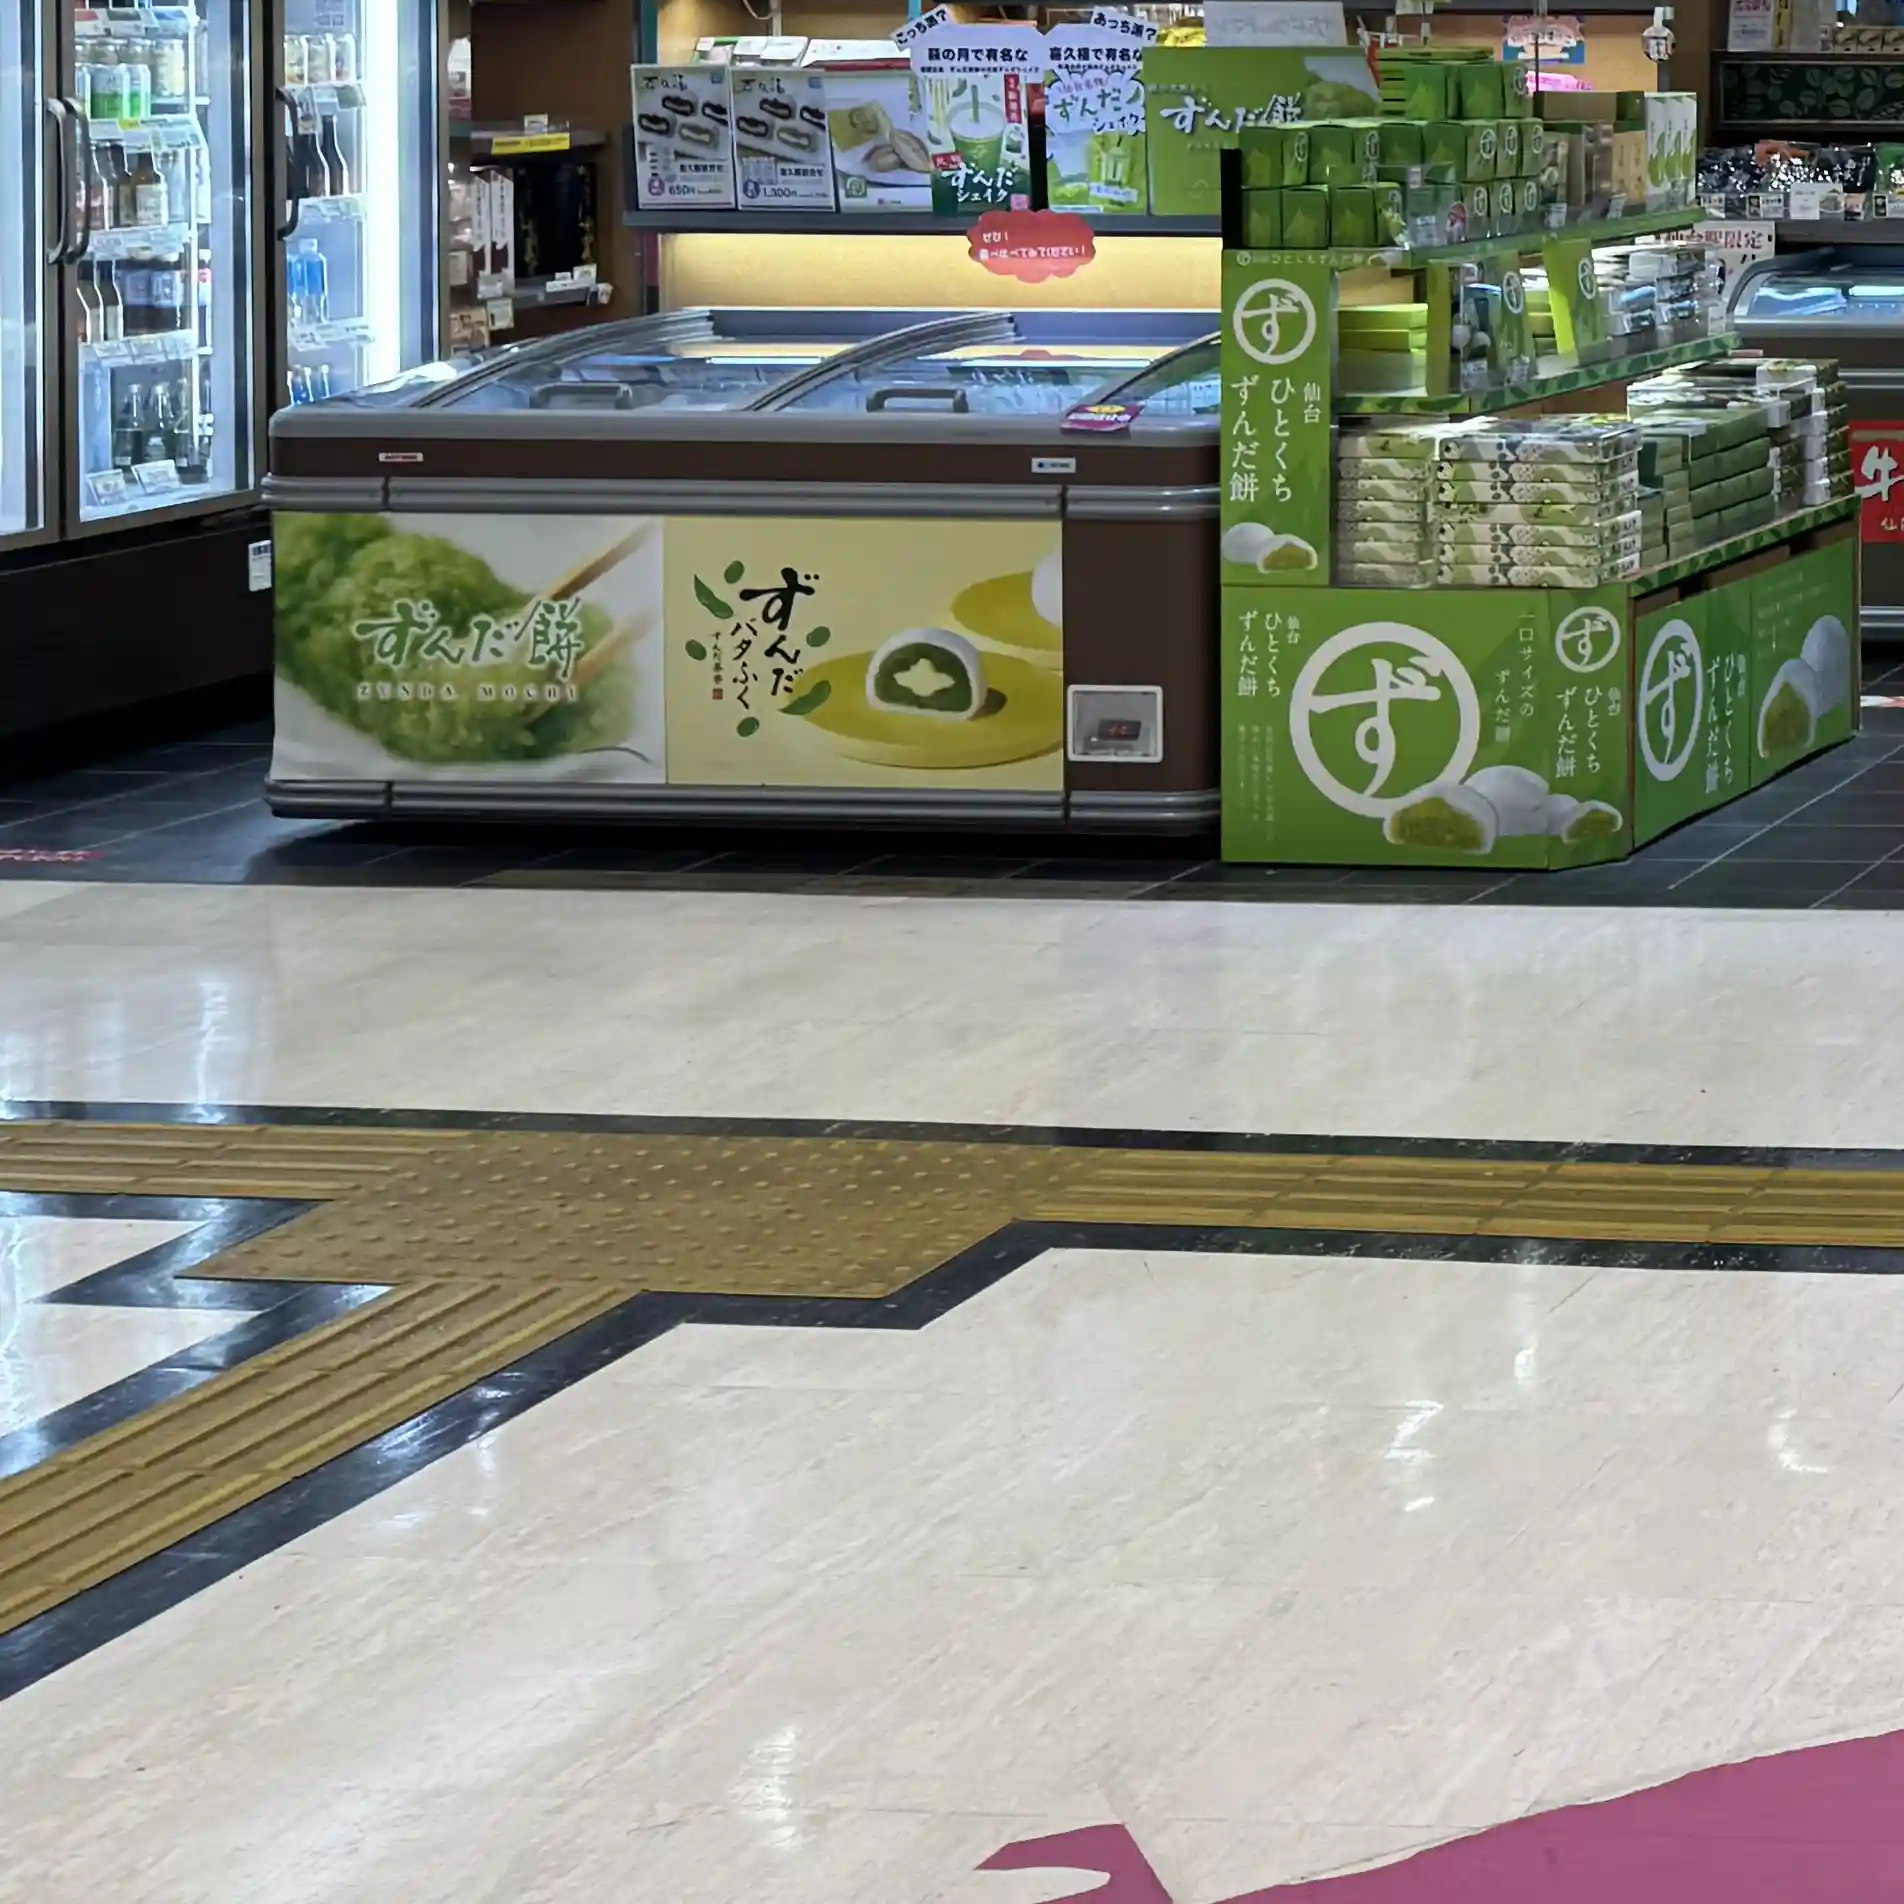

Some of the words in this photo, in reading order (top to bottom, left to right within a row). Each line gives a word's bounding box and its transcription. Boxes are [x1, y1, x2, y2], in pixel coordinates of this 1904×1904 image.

[1229, 374, 1260, 503] ずんだ餅
[1270, 377, 1296, 503] ひとくち
[1303, 381, 1321, 424] 仙台
[352, 595, 587, 683] ずんだ餅
[1237, 609, 1259, 698] ずんだ餅
[1264, 612, 1283, 698] ひとくち
[1555, 685, 1578, 779] ずんだ餅
[1583, 685, 1602, 774] ひとくち
